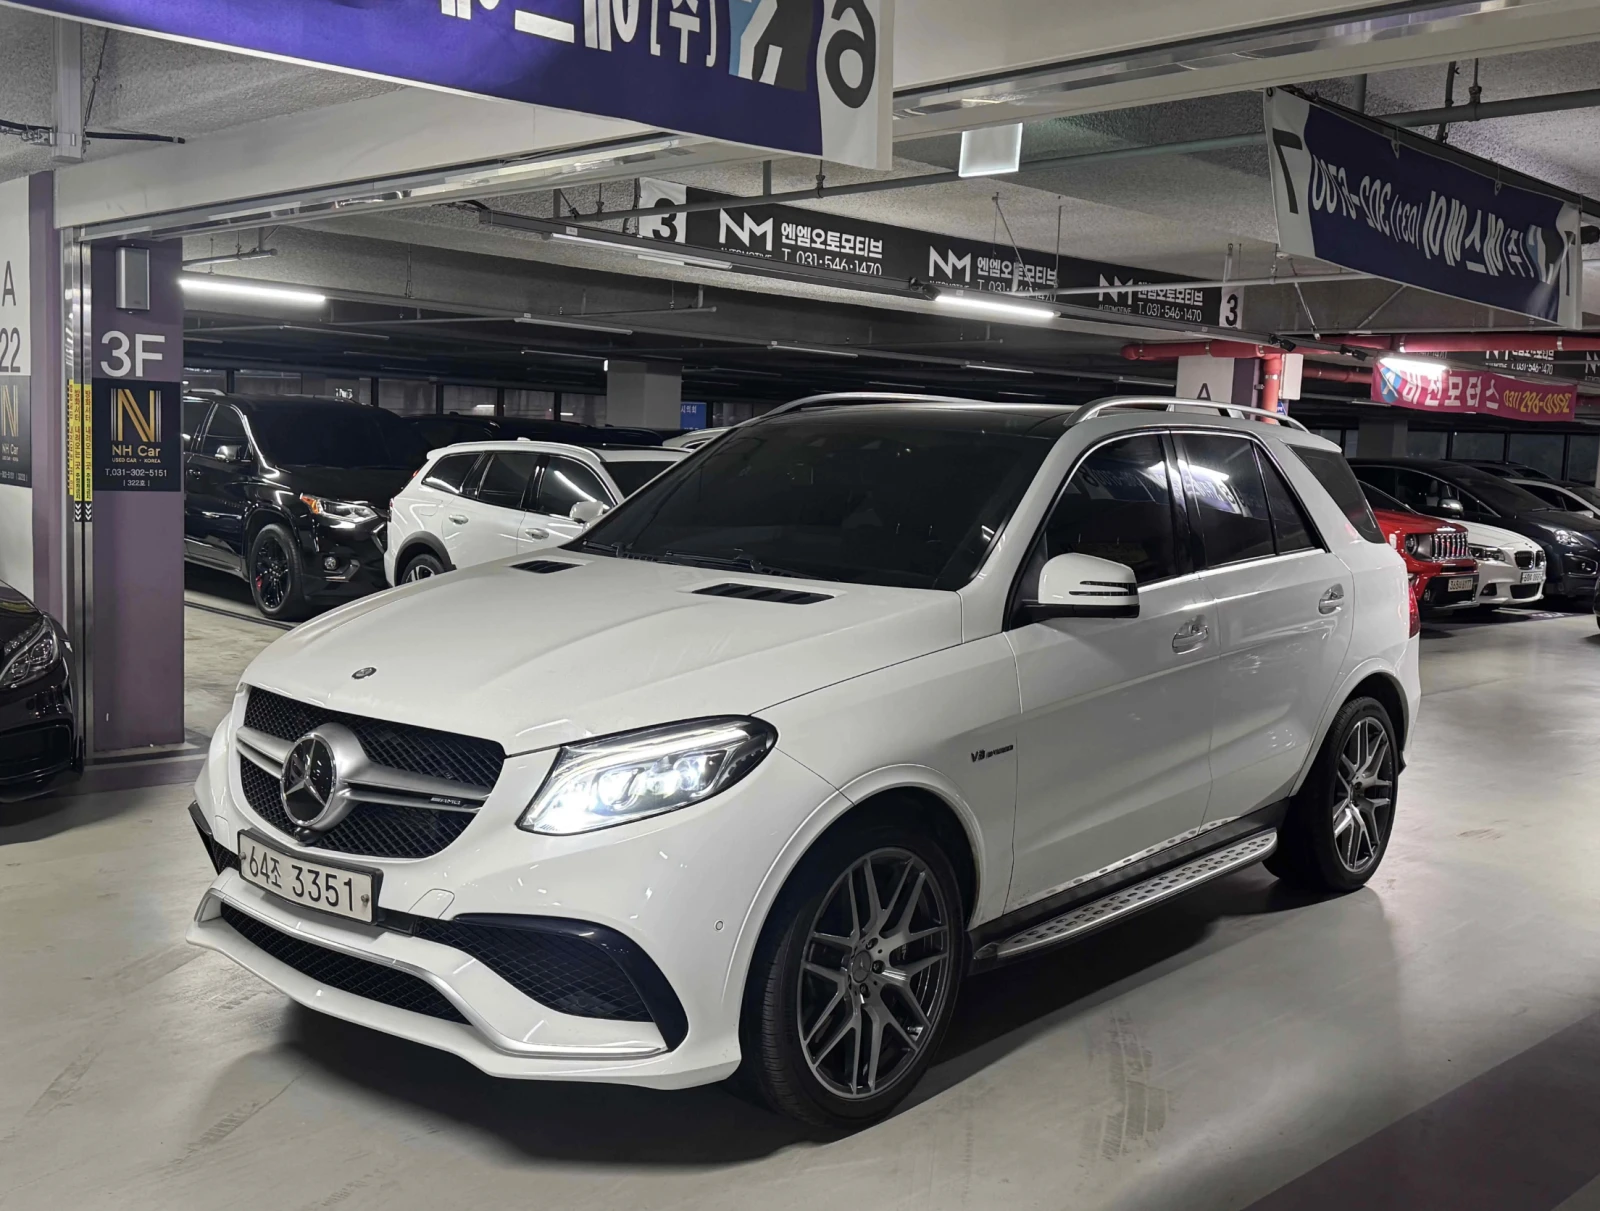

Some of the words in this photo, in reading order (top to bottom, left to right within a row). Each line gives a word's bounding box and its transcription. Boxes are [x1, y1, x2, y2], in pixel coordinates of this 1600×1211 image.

[652, 197, 678, 242] 3
[781, 222, 883, 259] 엔엠오토모티브
[2, 260, 17, 307] A
[1225, 293, 1239, 327] 3
[100, 330, 166, 378] 3F
[1197, 382, 1211, 401] A
[111, 444, 132, 456] NH
[137, 445, 161, 457] Car
[249, 845, 282, 890] 64조
[291, 865, 354, 912] 3351
